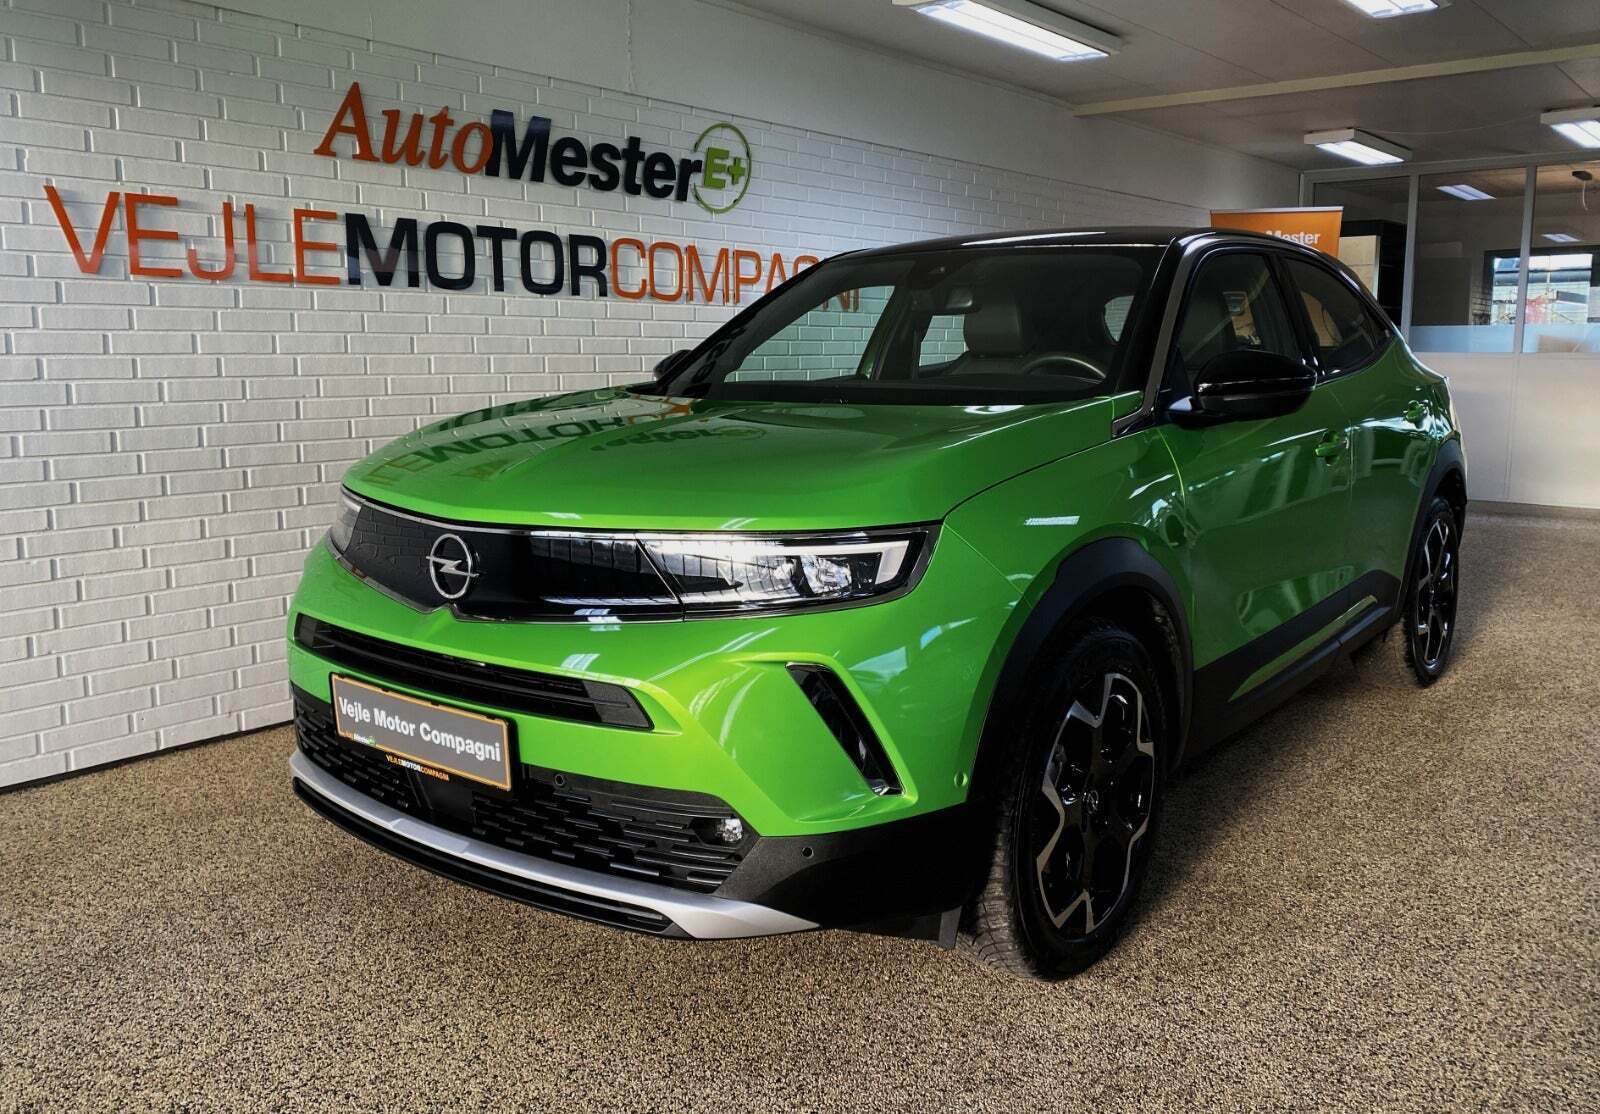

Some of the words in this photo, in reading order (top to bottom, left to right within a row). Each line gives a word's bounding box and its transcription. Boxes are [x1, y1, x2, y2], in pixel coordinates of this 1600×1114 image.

[313, 81, 702, 203] AutoMester
[338, 696, 371, 724] Vejle
[374, 708, 416, 737] Motor
[420, 722, 501, 762] Compagni
